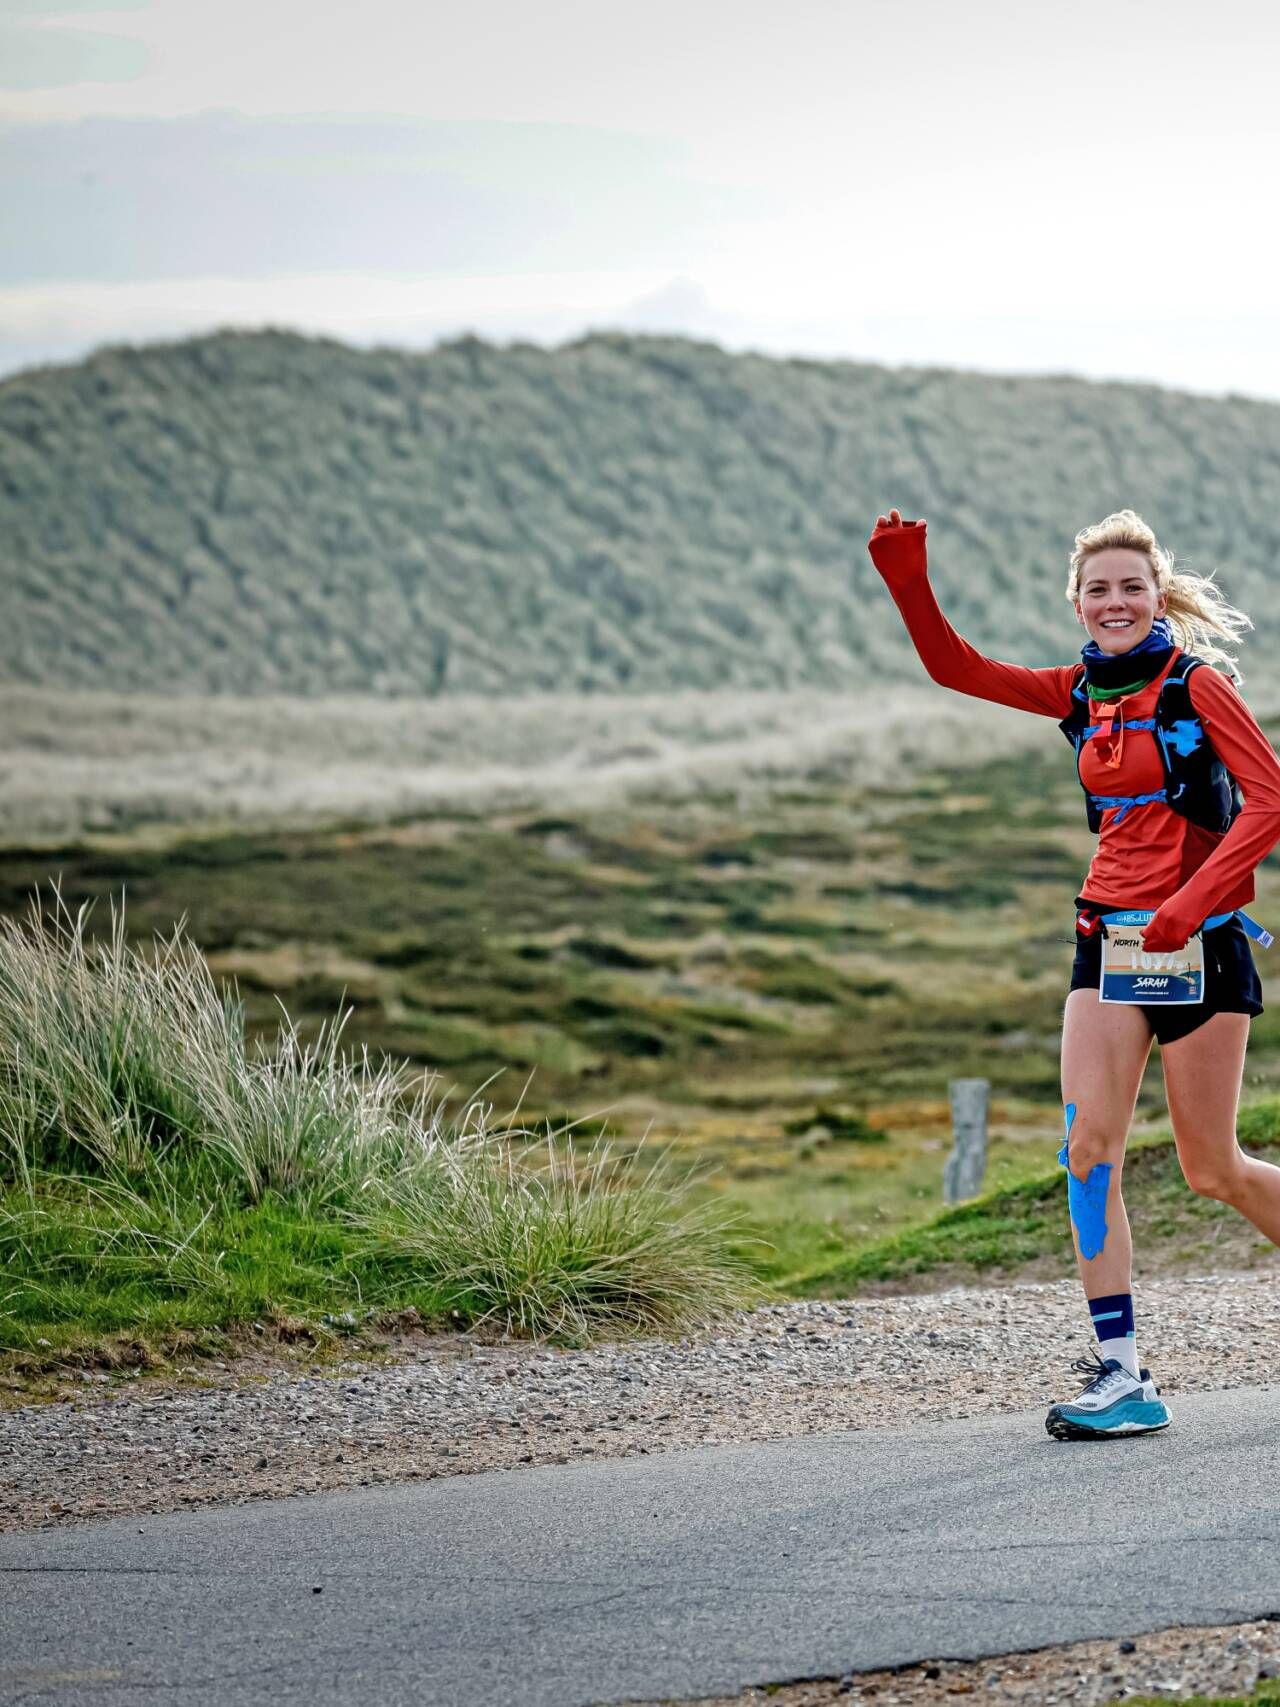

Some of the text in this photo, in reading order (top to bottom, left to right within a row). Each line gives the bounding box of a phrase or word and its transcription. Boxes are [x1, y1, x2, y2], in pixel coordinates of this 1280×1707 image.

[1122, 913, 1152, 923] ABSOLUT
[1113, 937, 1139, 948] NORTH
[1132, 976, 1169, 988] SARAH
